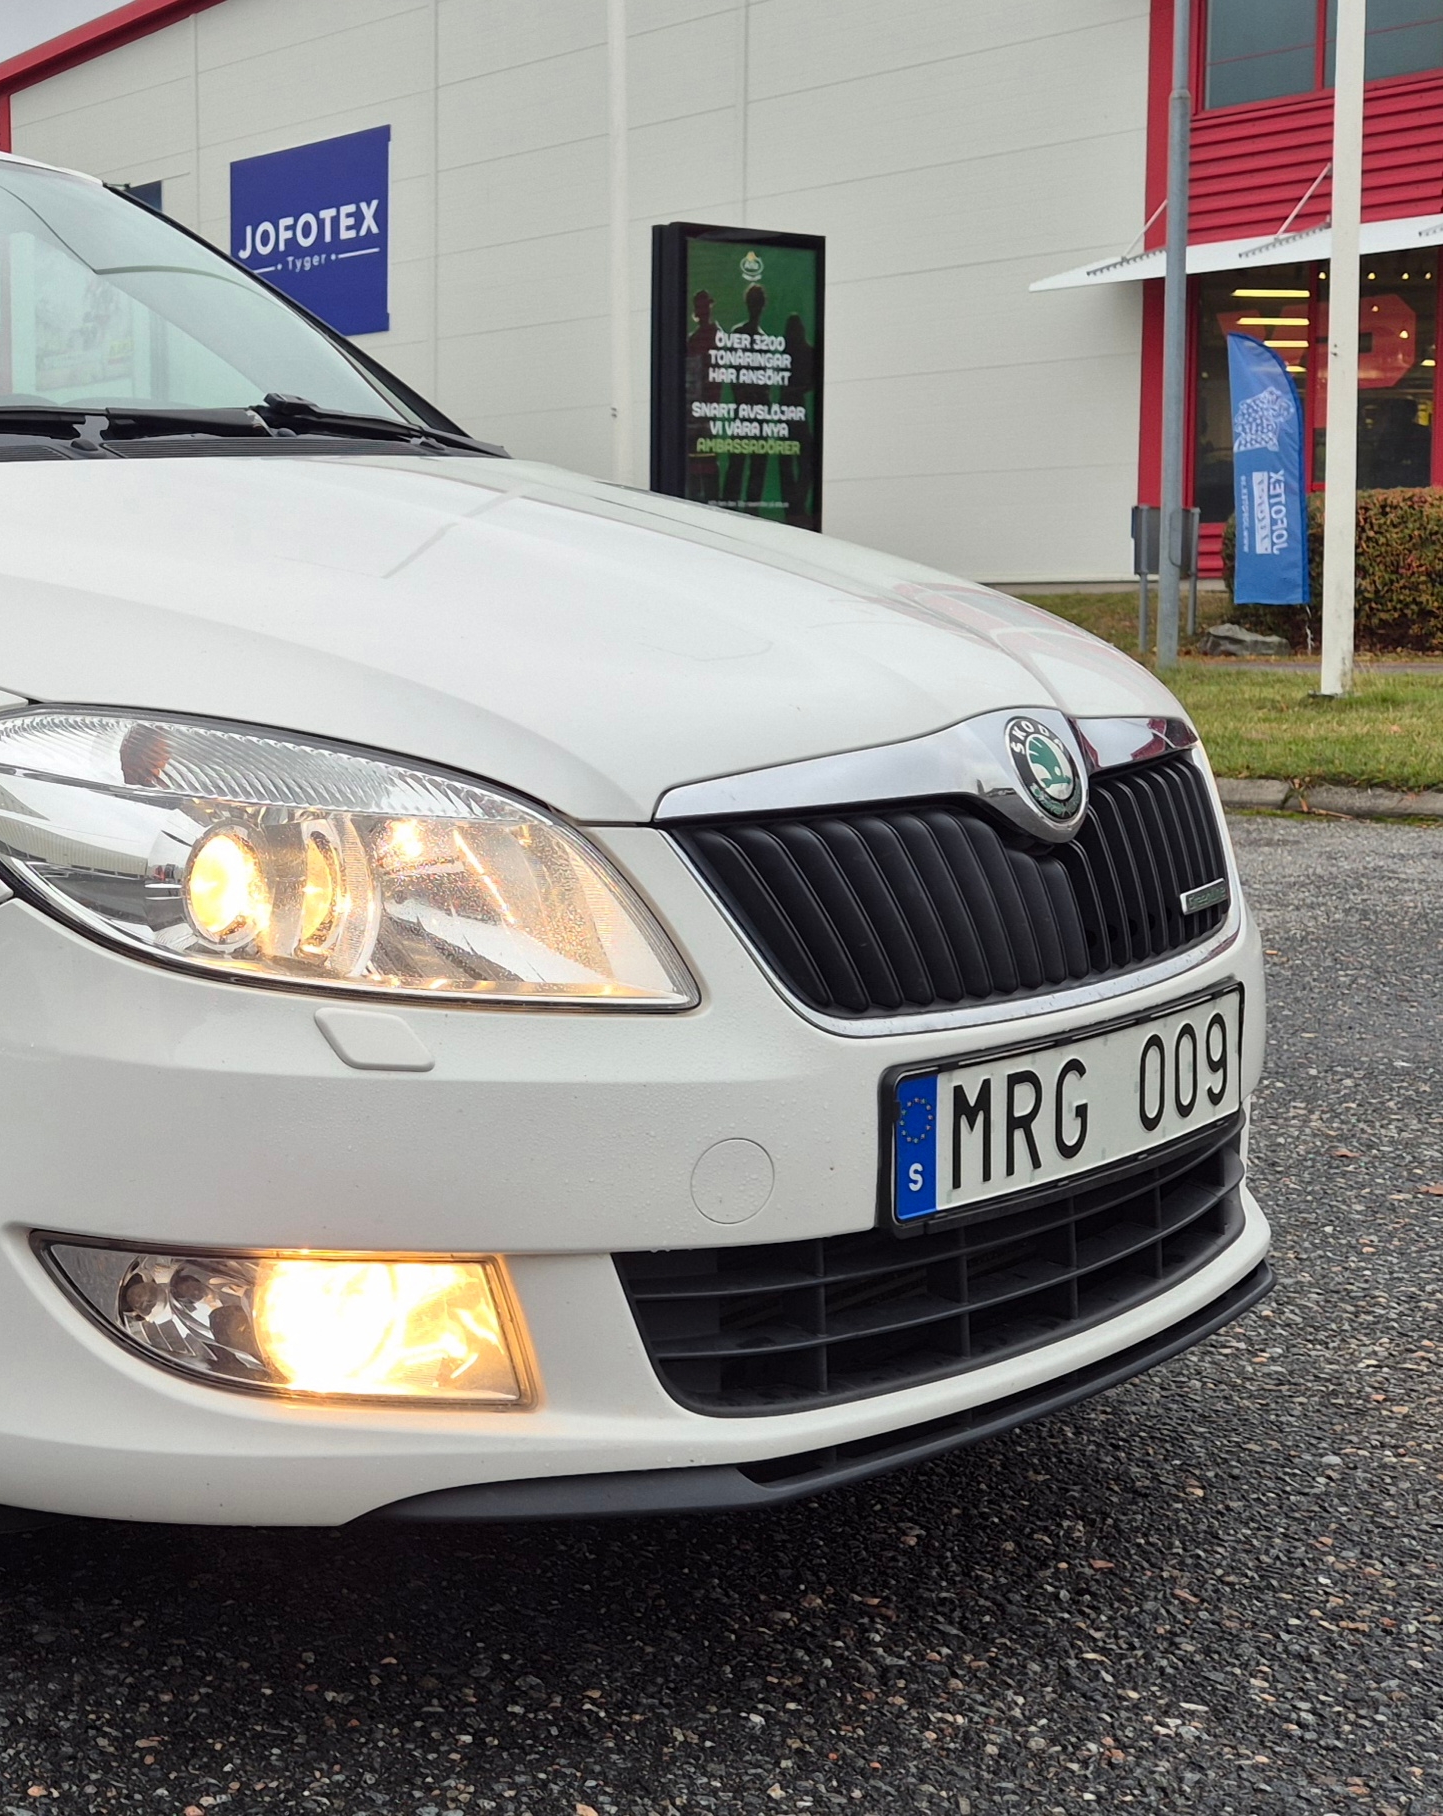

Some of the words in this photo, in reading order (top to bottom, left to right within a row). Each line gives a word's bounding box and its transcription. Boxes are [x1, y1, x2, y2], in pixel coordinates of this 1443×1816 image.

[238, 199, 380, 260] JOFOTEX
[286, 253, 327, 272] Tyger
[715, 330, 751, 349] ÖVER
[753, 334, 786, 352] 3200
[708, 349, 792, 369] TONÅRINGAR
[708, 367, 737, 383] HAR
[739, 369, 792, 386] ANSÖKT
[692, 401, 737, 418] SNART
[738, 403, 806, 421] AVSLÖJAR
[709, 420, 723, 436] VI
[725, 419, 761, 437] VÅRA
[762, 422, 789, 438] NYA
[696, 437, 801, 455] AMBASSADÖRER
[952, 1057, 1089, 1190] MRG
[1139, 1012, 1229, 1132] 009
[908, 1162, 924, 1192] S
